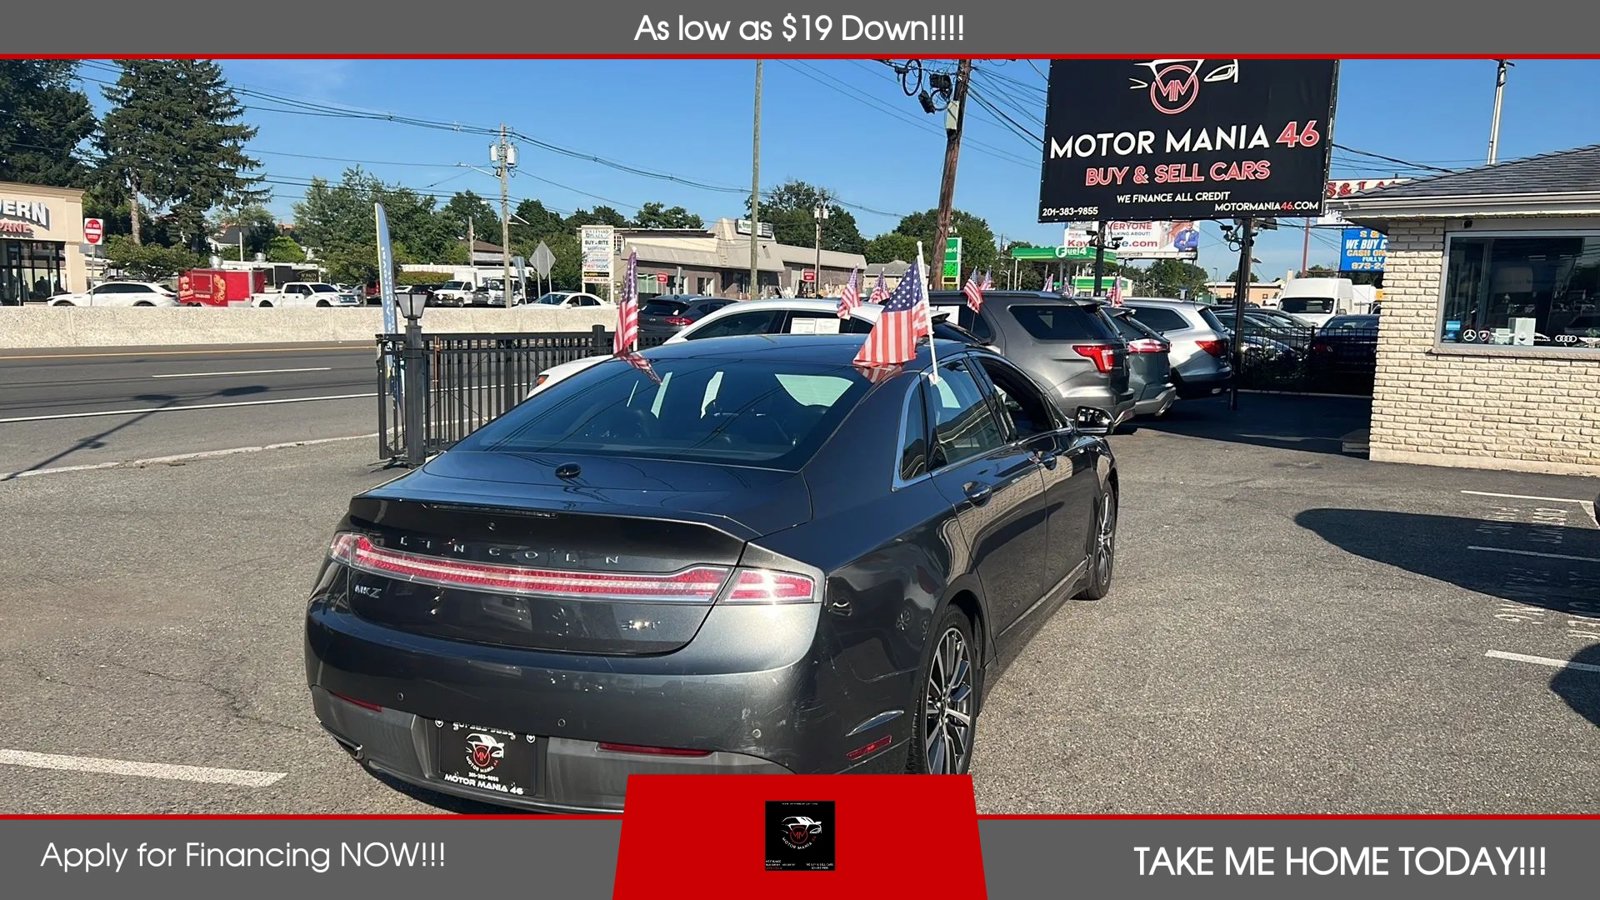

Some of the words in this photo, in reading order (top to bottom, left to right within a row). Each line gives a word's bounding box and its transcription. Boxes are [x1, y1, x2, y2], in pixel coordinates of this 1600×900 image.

[1050, 130, 1155, 159] MOTOR
[1166, 124, 1270, 153] MANIA
[1276, 120, 1320, 148] 46
[1085, 166, 1129, 186] BUY
[1133, 165, 1149, 185] &
[1154, 164, 1204, 183] SELL
[1209, 160, 1271, 181] CARS
[1116, 194, 1132, 204] WE
[1133, 193, 1174, 203] FINANCE
[1175, 192, 1194, 202] ALL
[1195, 191, 1230, 202] CREDIT
[0, 200, 48, 226] ERN
[1041, 206, 1099, 217] 201-383-9855
[1214, 201, 1319, 212] MOTORMANIA46.COM
[1107, 222, 1153, 230] VERYONE
[1346, 239, 1359, 249] WE
[1360, 239, 1379, 249] BUY
[1380, 239, 1388, 249] C
[400, 535, 619, 565] LINCOLN
[354, 585, 383, 599] MKZ
[444, 773, 476, 787] MOTOR
[477, 780, 508, 793] MANIA
[510, 787, 524, 795] 46
